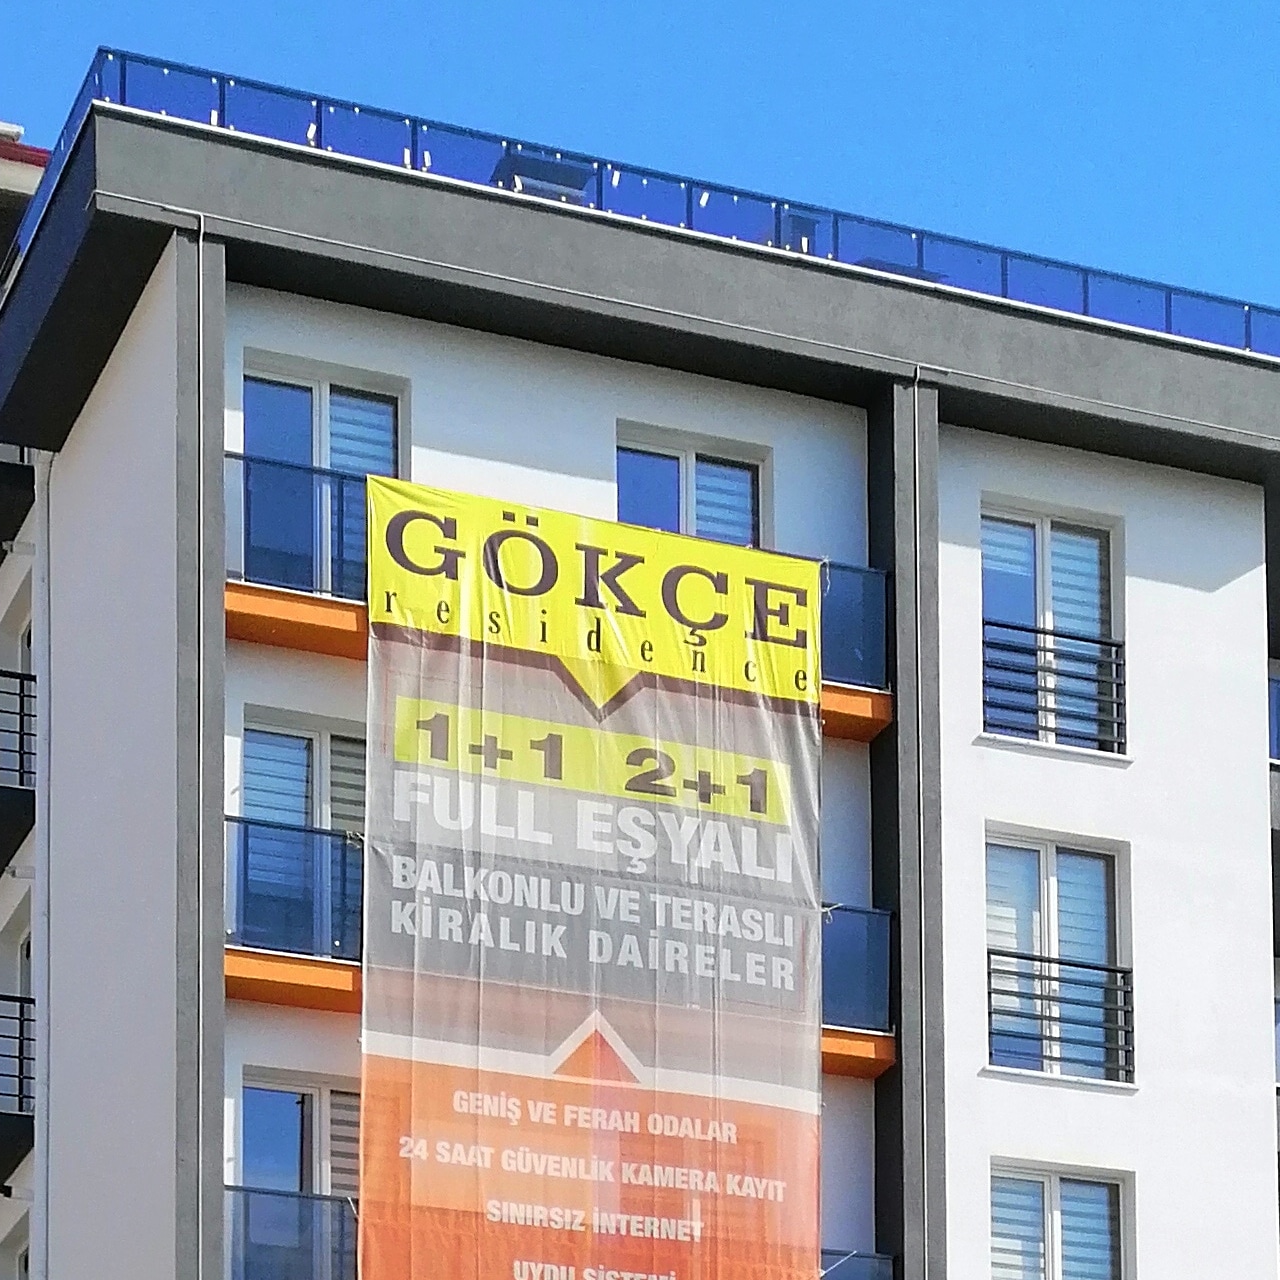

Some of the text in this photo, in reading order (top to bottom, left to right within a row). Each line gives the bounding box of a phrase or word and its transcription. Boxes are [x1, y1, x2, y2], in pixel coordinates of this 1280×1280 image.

[385, 510, 808, 650] GÖKÇE
[384, 588, 808, 692] residence
[416, 712, 768, 814] 1+1 2+1
[392, 770, 793, 884] FULL EŞYALI
[391, 896, 795, 991] KİRALIK DAİRELER
[392, 854, 794, 947] BALKONLU VE TERASLI
[452, 1090, 738, 1144] GENİŞ VE FERAH ODALAR
[399, 1135, 787, 1203] 24 SAAT GÜVENLİK KAMERA KAYIT
[486, 1199, 704, 1243] SINIRSIZ İNTERNET
